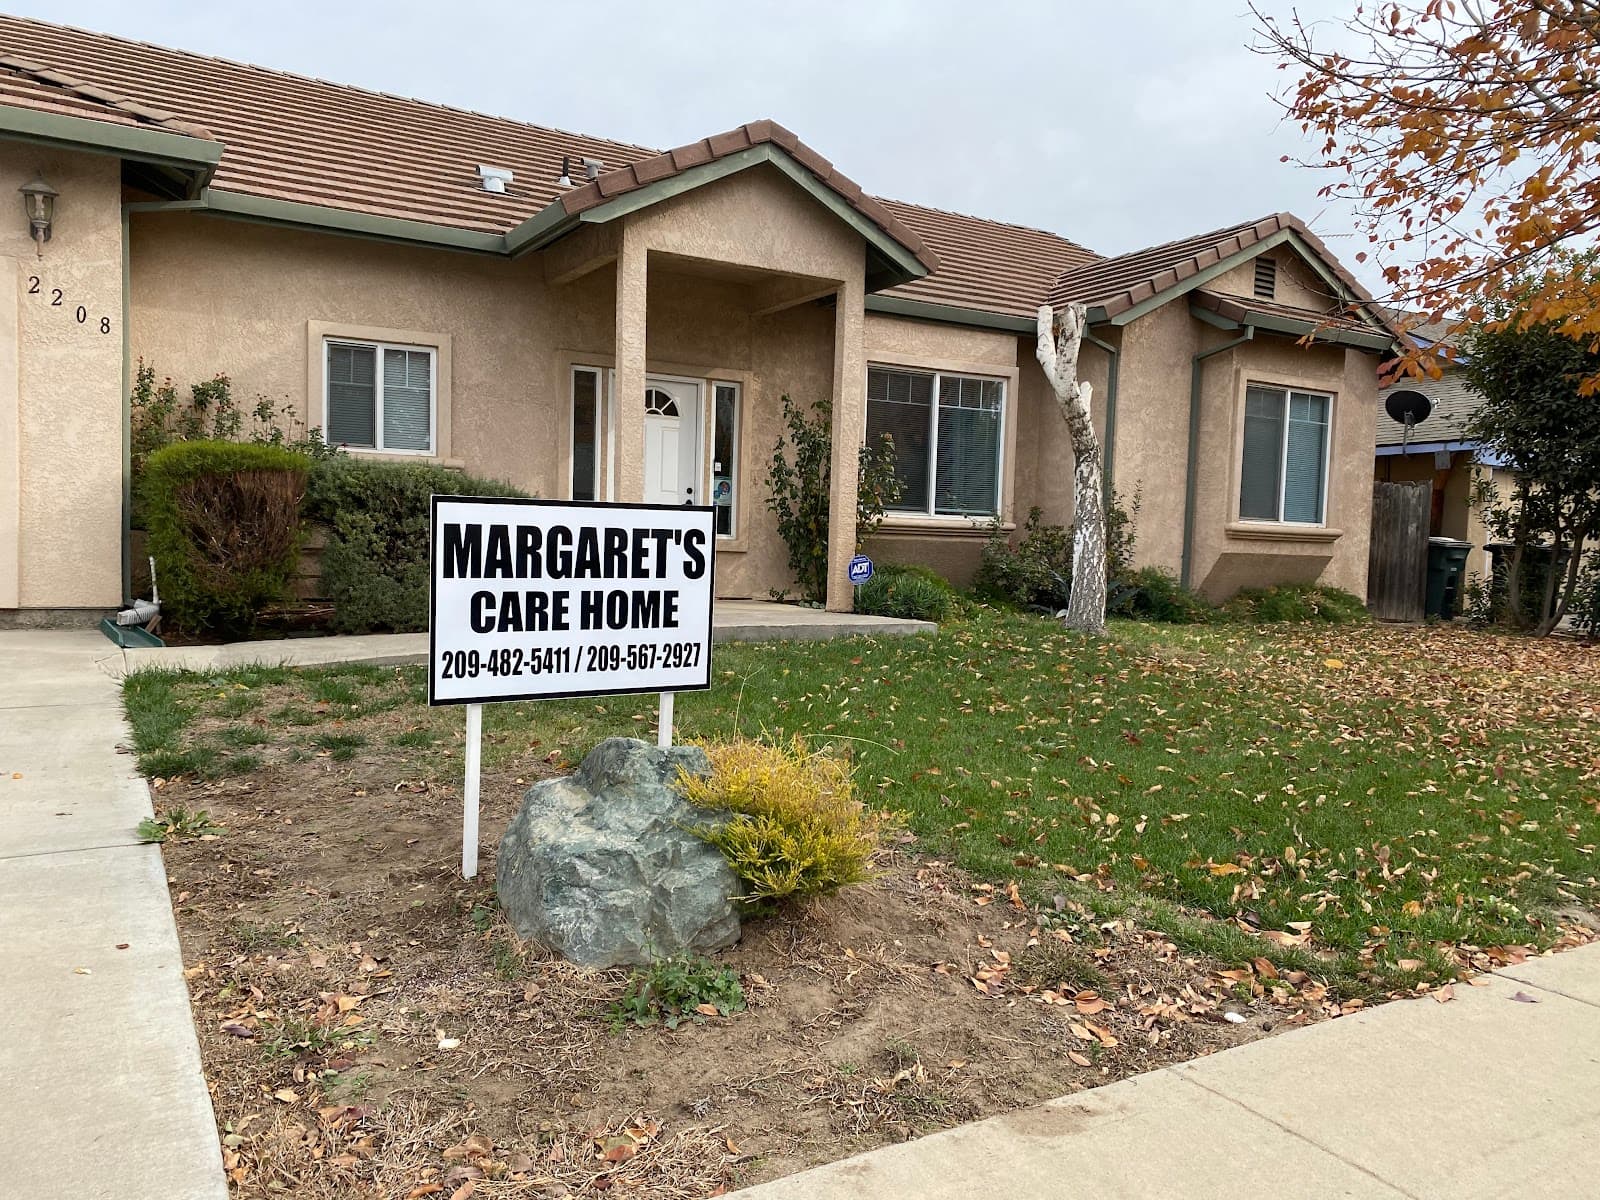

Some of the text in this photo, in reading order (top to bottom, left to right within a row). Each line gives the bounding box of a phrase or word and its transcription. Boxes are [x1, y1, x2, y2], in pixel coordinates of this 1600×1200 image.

[28, 276, 110, 334] 2208
[443, 523, 706, 580] MARGARET'S
[852, 562, 870, 575] ADT
[470, 590, 679, 634] CARE HOME
[441, 642, 701, 679] 209-482-5411 / 209-567-2927
